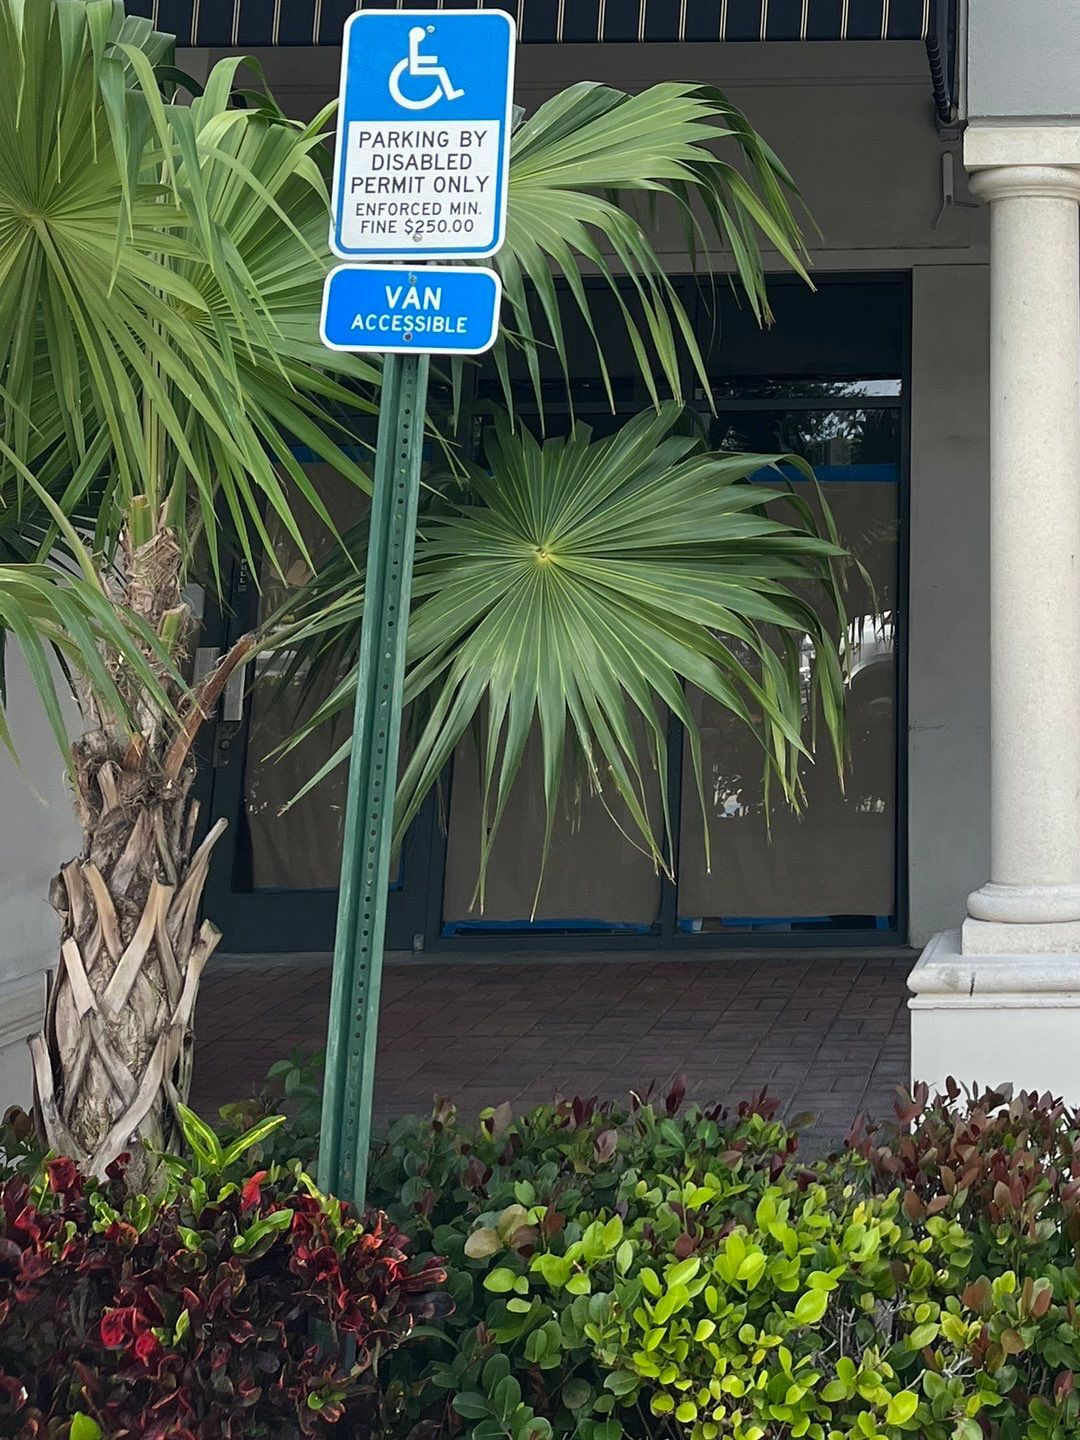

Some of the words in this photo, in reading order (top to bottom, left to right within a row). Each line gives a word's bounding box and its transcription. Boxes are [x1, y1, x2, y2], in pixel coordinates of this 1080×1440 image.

[358, 131, 449, 149] PARKING
[459, 130, 488, 148] BY
[371, 153, 472, 171] DISABLED
[351, 176, 425, 194] PERMIT
[433, 175, 489, 194] ONLY
[356, 202, 442, 216] ENFORCED
[449, 202, 482, 216] MIN.
[361, 220, 398, 234] FINE
[404, 219, 474, 235] $250.00
[385, 286, 442, 310] VAN
[350, 313, 468, 334] ACCESSIBLE
